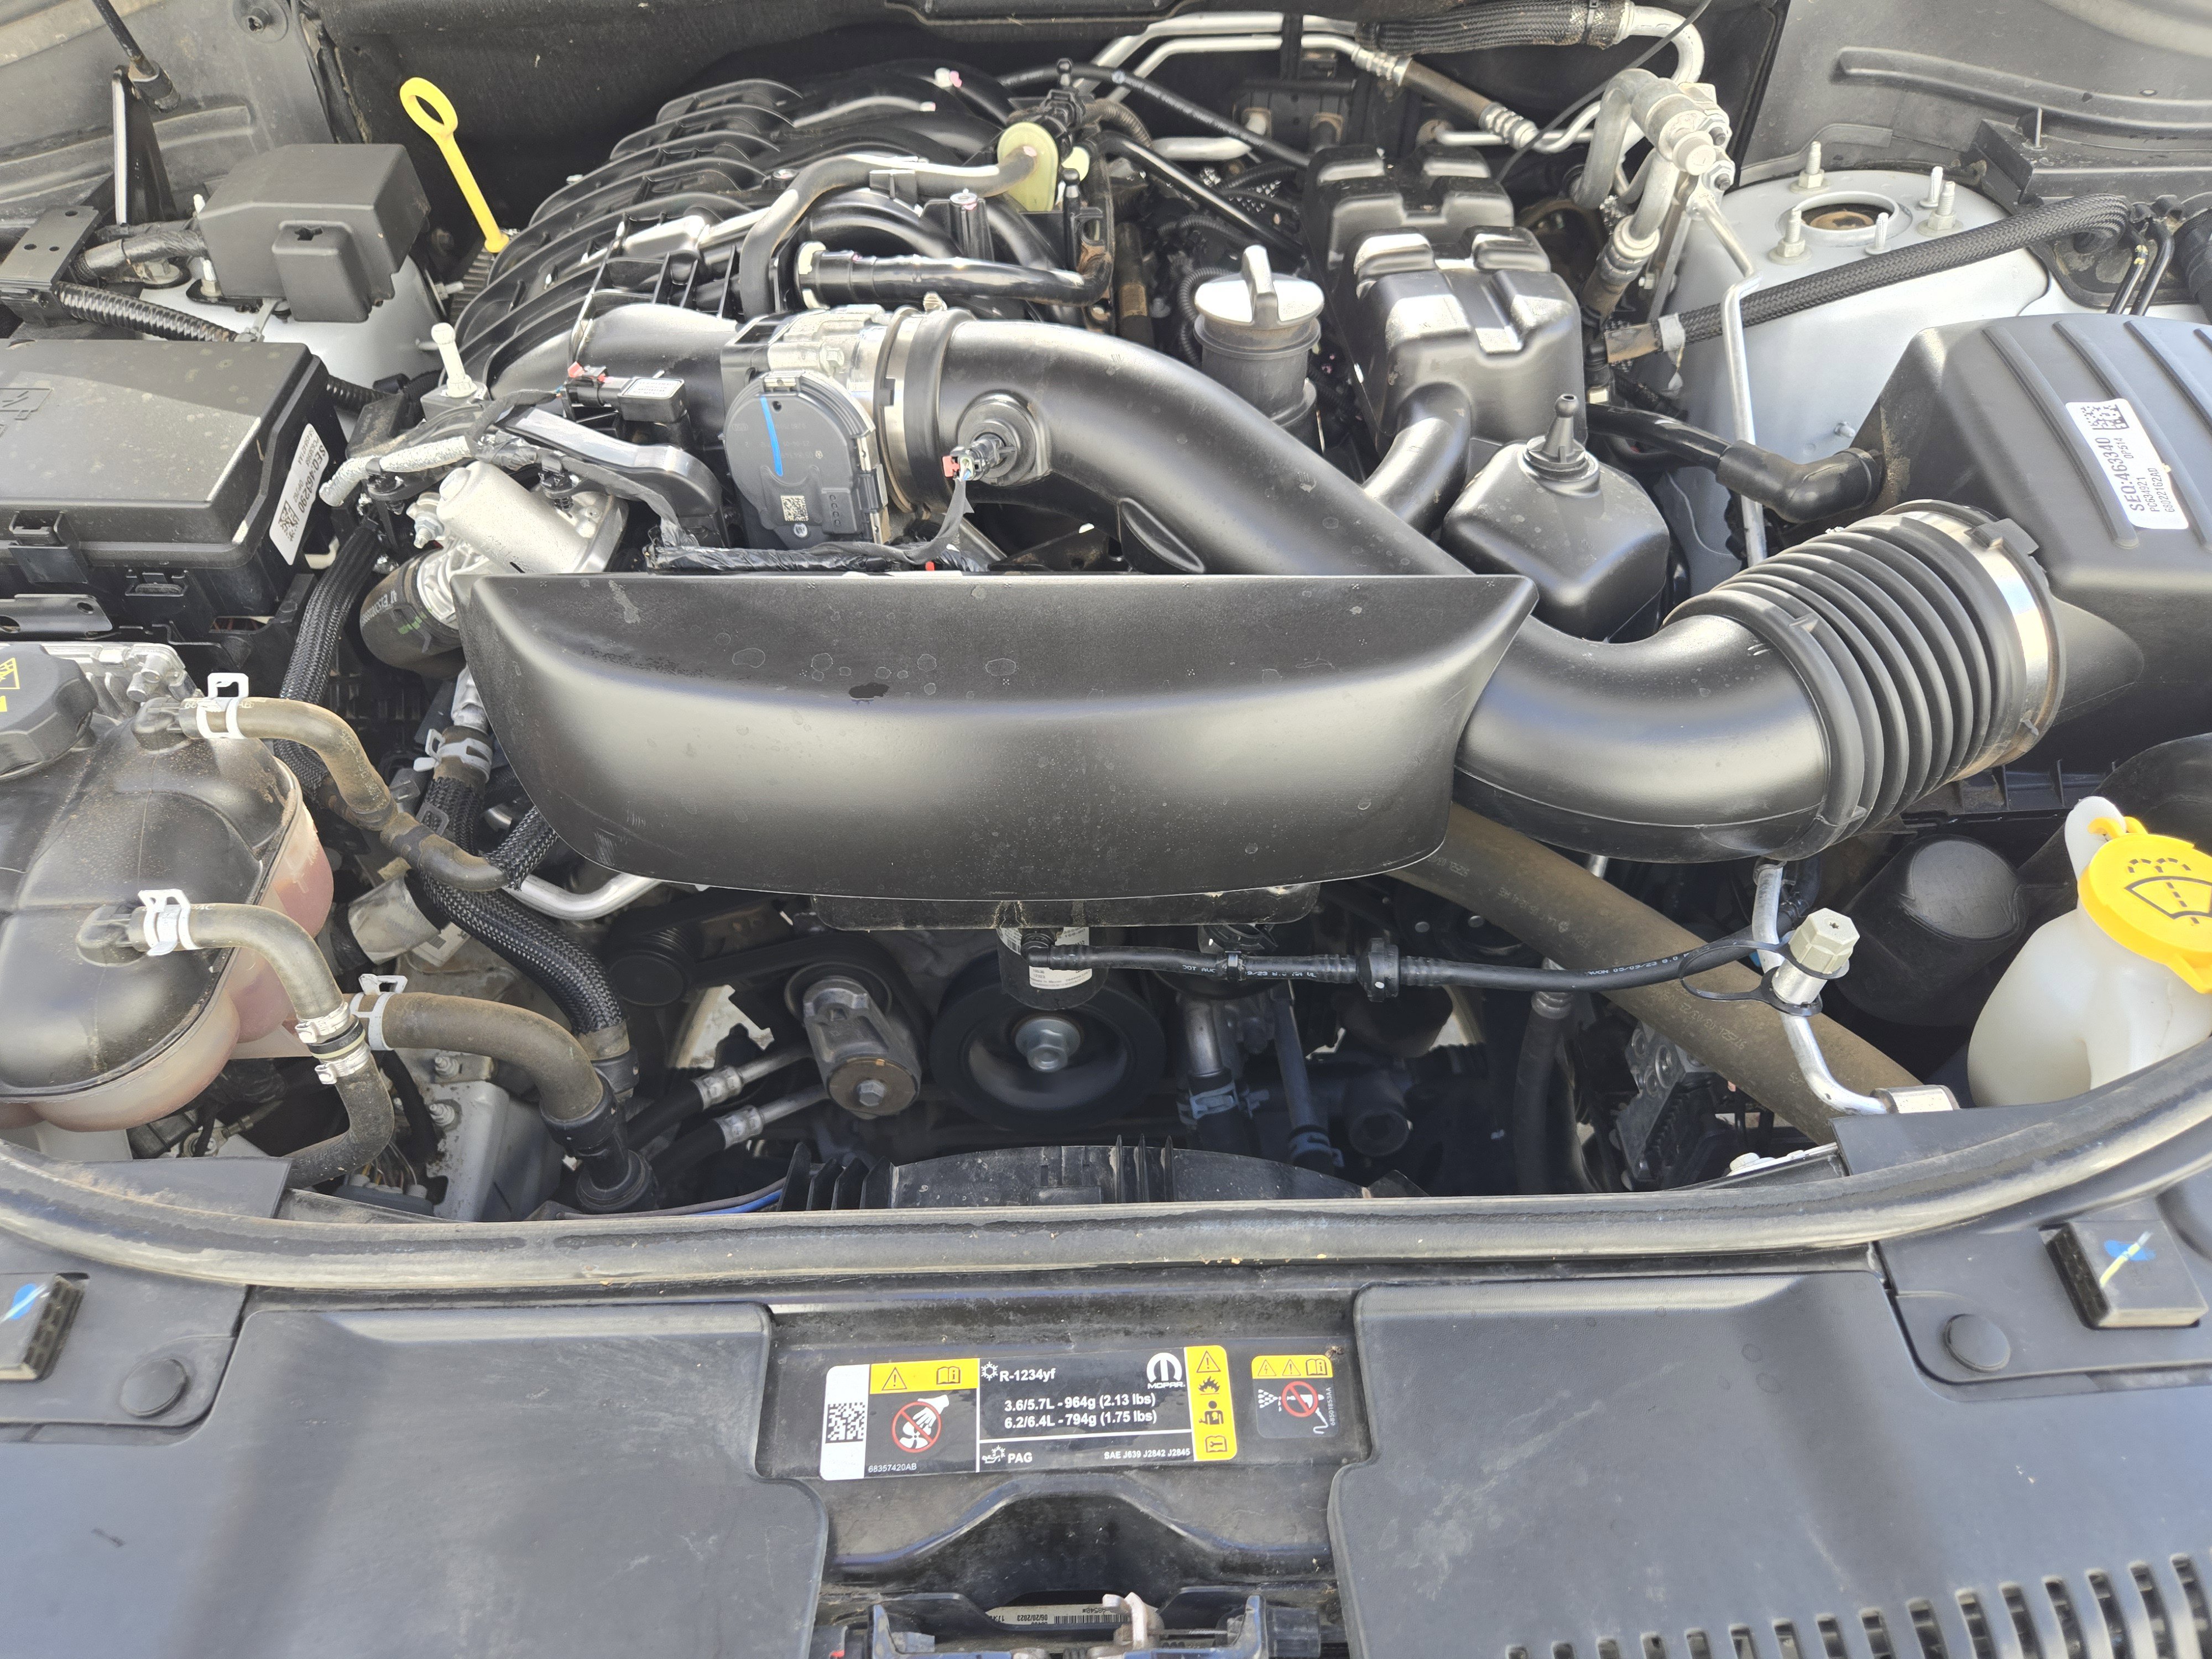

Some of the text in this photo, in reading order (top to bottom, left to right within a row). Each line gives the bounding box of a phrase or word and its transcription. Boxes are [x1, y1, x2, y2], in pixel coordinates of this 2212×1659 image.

[2095, 437, 2145, 512] SEQ:463340
[2136, 477, 2160, 512] PC634921
[2147, 468, 2175, 512] 68022162AD
[999, 1368, 1056, 1383] R-1234yf
[1004, 1397, 1055, 1412] 3.6/5.7L
[1065, 1396, 1096, 1410] 964g
[1099, 1394, 1130, 1408] (2.13
[1133, 1392, 1156, 1407] lbs)
[1004, 1415, 1056, 1429] 6.2/6.4L
[1065, 1413, 1097, 1427] 794g
[1100, 1411, 1131, 1426] (1.75
[1134, 1409, 1157, 1425] lbs)
[1008, 1452, 1033, 1464] PAG
[1104, 1448, 1191, 1460] SAE J639 J2842 J2845
[868, 1463, 917, 1473] 68357420AB
